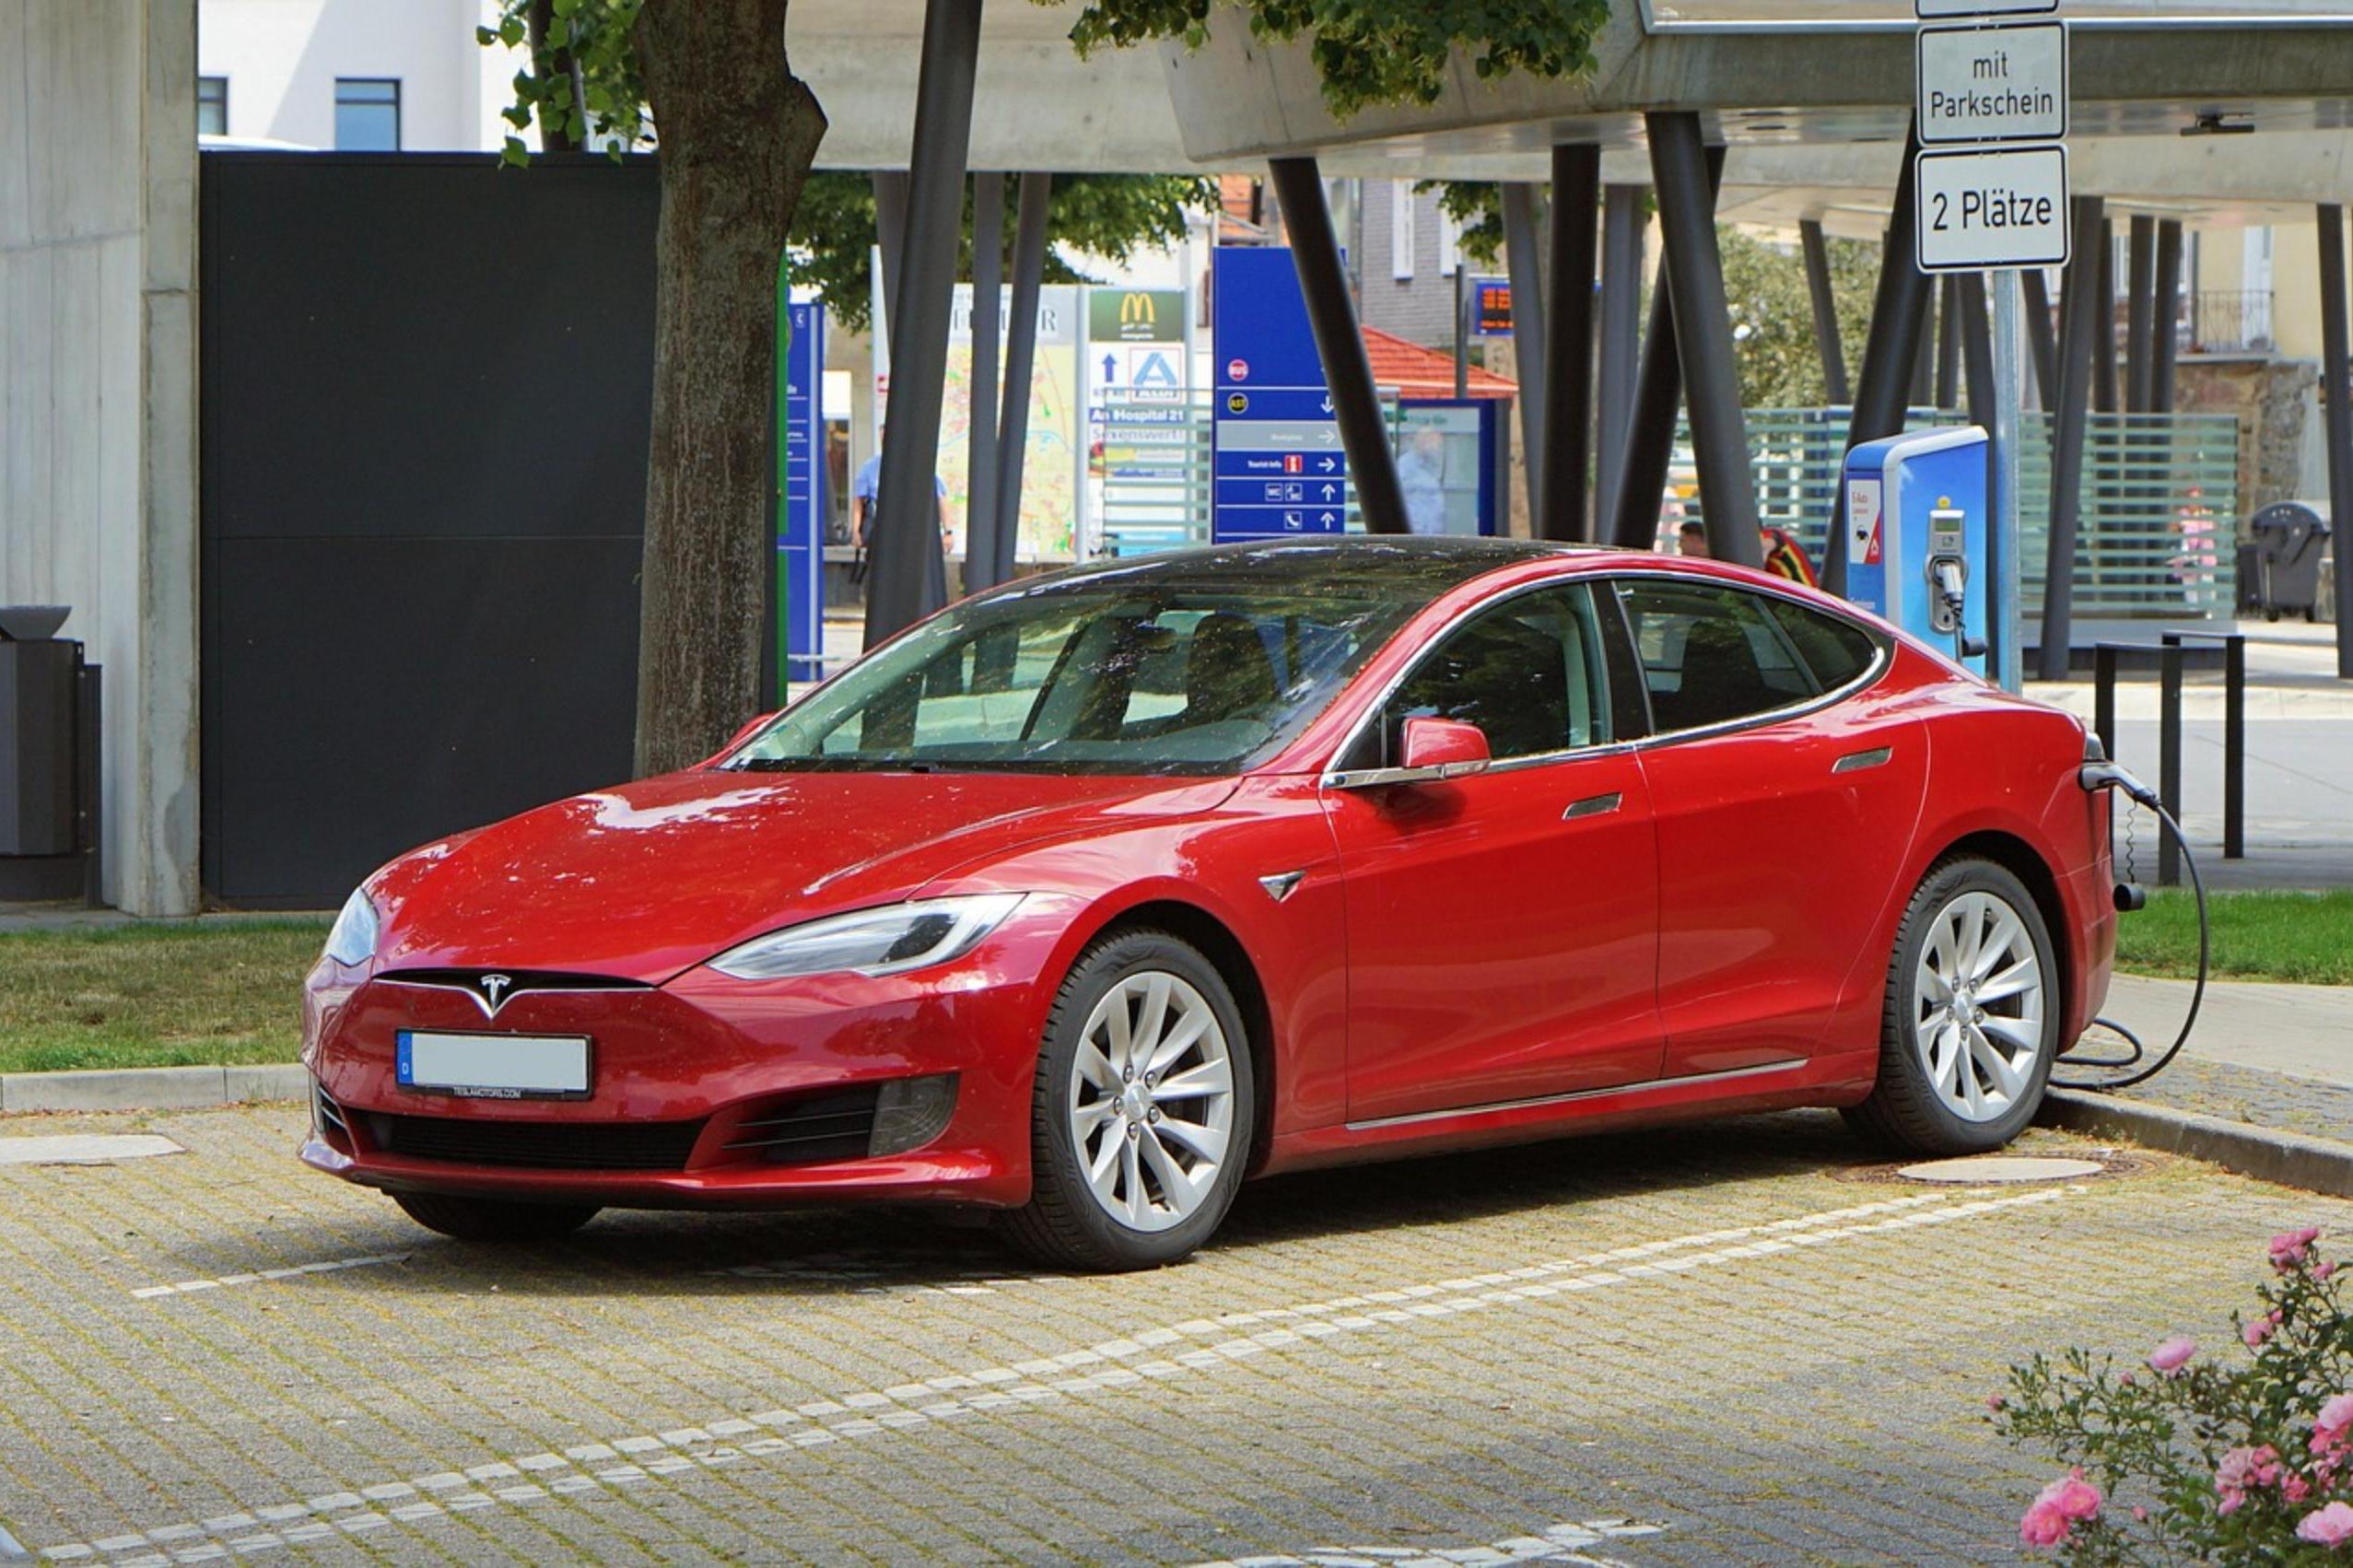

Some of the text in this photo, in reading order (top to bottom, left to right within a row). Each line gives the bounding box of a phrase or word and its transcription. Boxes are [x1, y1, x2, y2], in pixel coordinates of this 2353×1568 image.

[1973, 50, 2008, 78] mit
[1931, 87, 2053, 118] Parkschein
[1933, 189, 2051, 230] 2 Plätze
[1113, 410, 1166, 422] Hospital
[1168, 411, 1183, 420] 21
[402, 1062, 409, 1075] D
[453, 1087, 521, 1098] TESLAMOTORS.COM
